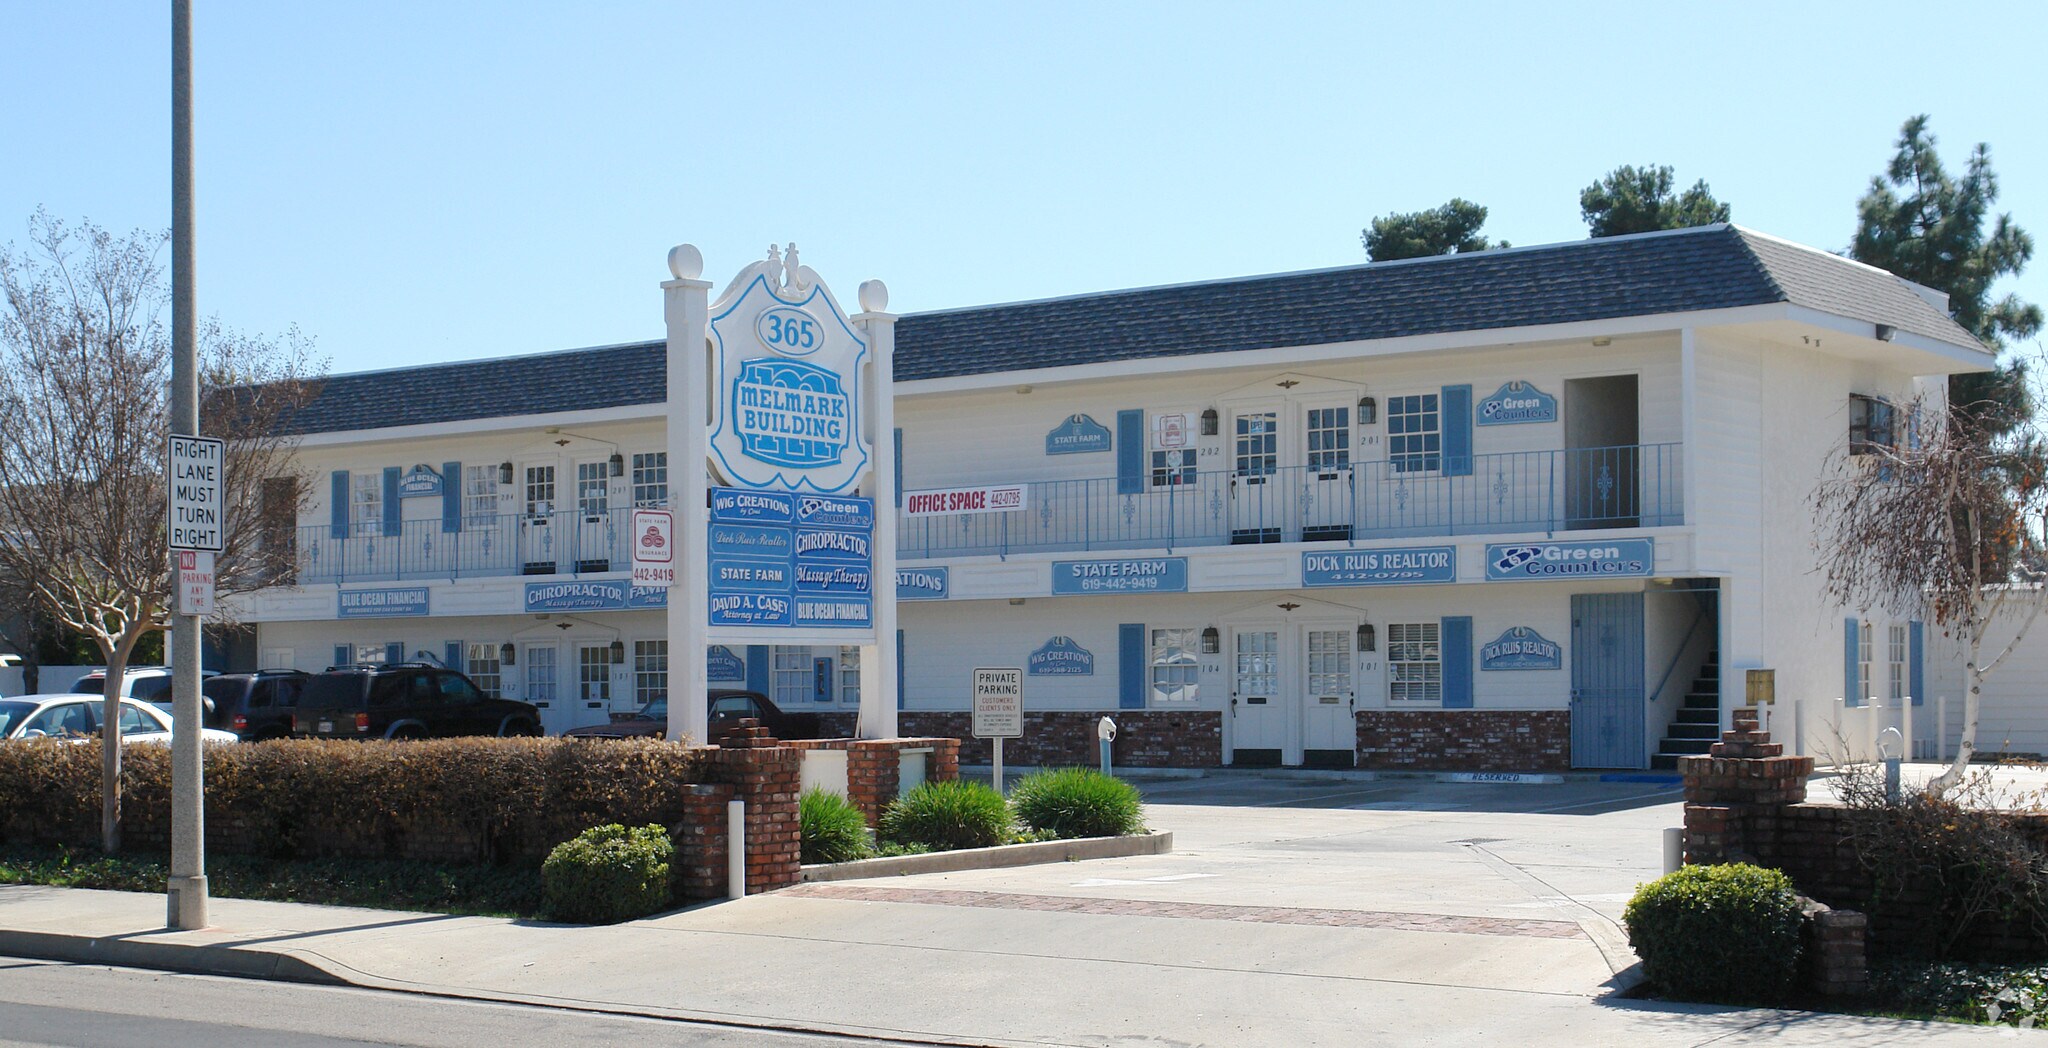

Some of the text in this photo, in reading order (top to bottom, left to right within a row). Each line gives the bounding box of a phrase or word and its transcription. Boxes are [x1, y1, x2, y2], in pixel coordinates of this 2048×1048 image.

[767, 314, 814, 348] 365
[740, 385, 844, 418] MELMARK
[1503, 397, 1540, 409] Green
[1494, 408, 1550, 420] Counters
[744, 409, 841, 440] BUILDING
[1055, 435, 1078, 445] STATE
[1079, 433, 1101, 442] FARM
[1361, 435, 1379, 446] 201
[175, 441, 216, 459] RIGHT
[1201, 447, 1220, 456] 202
[177, 463, 215, 481] LANE
[177, 485, 215, 502] MUST
[716, 494, 790, 515] WIG CREATIONS
[822, 499, 859, 514] Green
[908, 490, 1021, 514] OFFICE SPACE 442-0795
[177, 506, 215, 524] TURN
[813, 510, 869, 525] Counters
[175, 528, 216, 545] RIGHT
[715, 530, 787, 547] Dick Ruis Realtor
[796, 532, 867, 557] CHIROPRACTOR
[182, 552, 195, 568] NO
[1543, 545, 1620, 561] Green
[1072, 561, 1167, 577] STATE FARM
[1307, 552, 1449, 572] DICK RUIS REALTOR
[1525, 559, 1643, 575] Counters
[182, 572, 212, 585] PARKING
[634, 567, 674, 582] 442-9419
[720, 567, 783, 581] STATE FARM
[796, 565, 868, 590] Massage Therapy
[1330, 571, 1425, 580] 442-0795
[191, 586, 204, 595] ANY
[1081, 577, 1158, 590] 619-442-9419
[341, 590, 426, 607] BLUE OCEAN FINANCIAL
[528, 584, 622, 604] CHIROPRACTOR
[190, 597, 205, 607] TIME
[545, 599, 604, 608] Massage Therapy
[712, 594, 789, 615] DAVID A. CASEY
[722, 610, 753, 622] Attorney
[764, 611, 781, 620] Law
[797, 602, 868, 621] BLUE OCEAN FINANCIAL
[1031, 650, 1090, 665] WIG CREATIONS
[1485, 641, 1555, 661] DICK RUIS REALTOR
[1202, 664, 1220, 673] 104
[1360, 662, 1378, 671] 101
[979, 673, 1017, 683] PRIVATE
[978, 684, 1018, 695] PARKING
[979, 704, 1001, 712] CLIENTS
[1472, 772, 1520, 782] RESERVED
